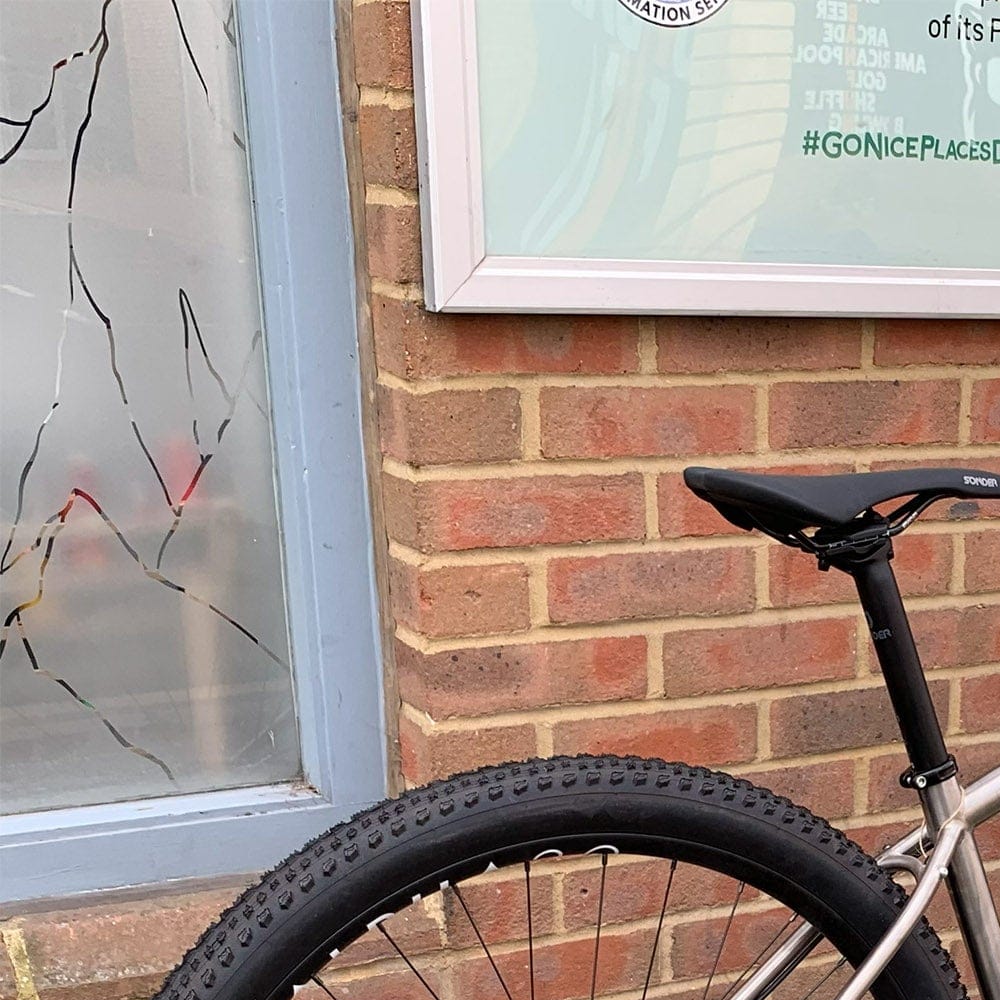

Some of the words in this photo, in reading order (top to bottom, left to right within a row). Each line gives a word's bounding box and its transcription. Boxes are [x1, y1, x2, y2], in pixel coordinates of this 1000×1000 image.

[928, 14, 951, 38] of
[957, 15, 984, 41] its
[963, 475, 998, 488] SONDER
